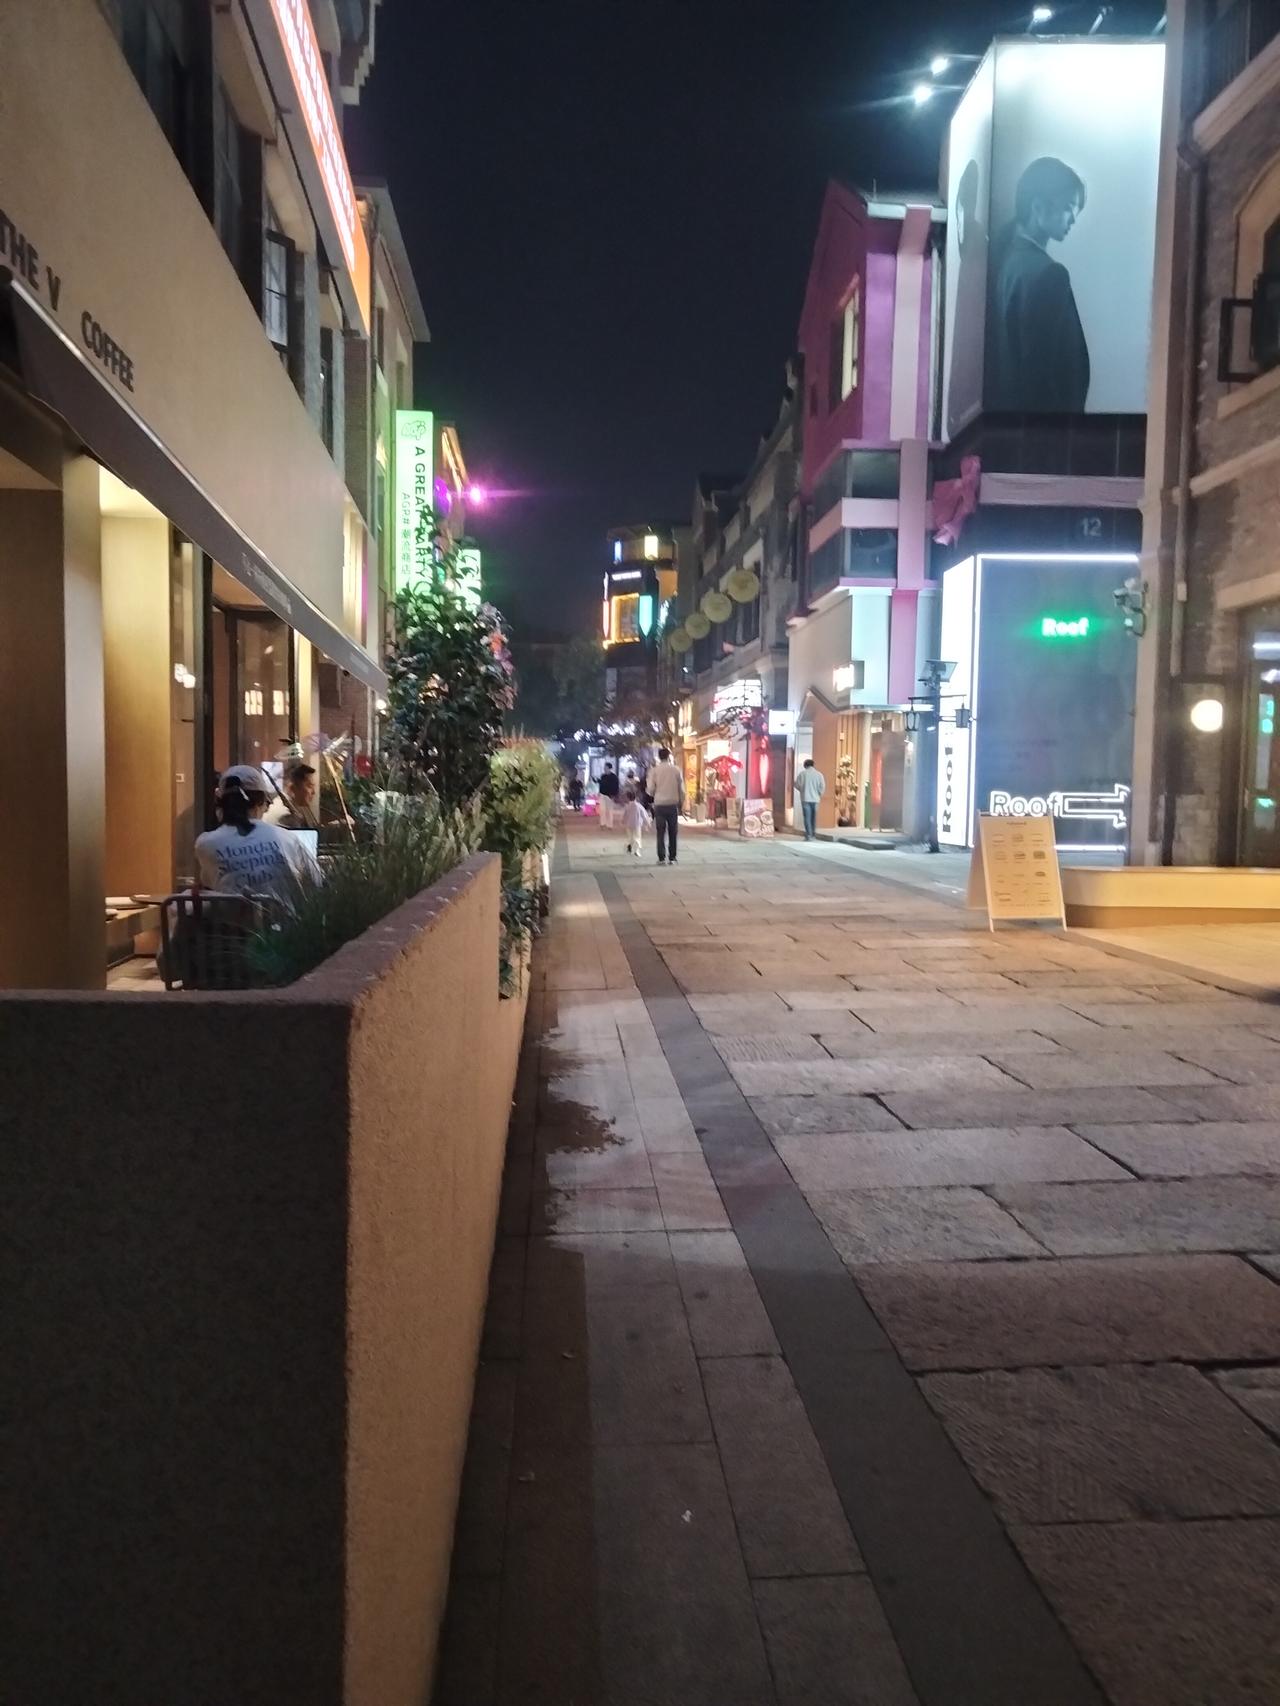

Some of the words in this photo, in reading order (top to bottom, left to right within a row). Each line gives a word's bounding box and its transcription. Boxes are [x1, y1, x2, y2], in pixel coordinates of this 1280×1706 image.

[46, 264, 61, 313] V
[81, 310, 134, 393] COFFEE
[415, 446, 426, 457] A
[1082, 517, 1101, 537] 12
[1041, 616, 1089, 637] Roof
[989, 790, 1063, 817] Roof
